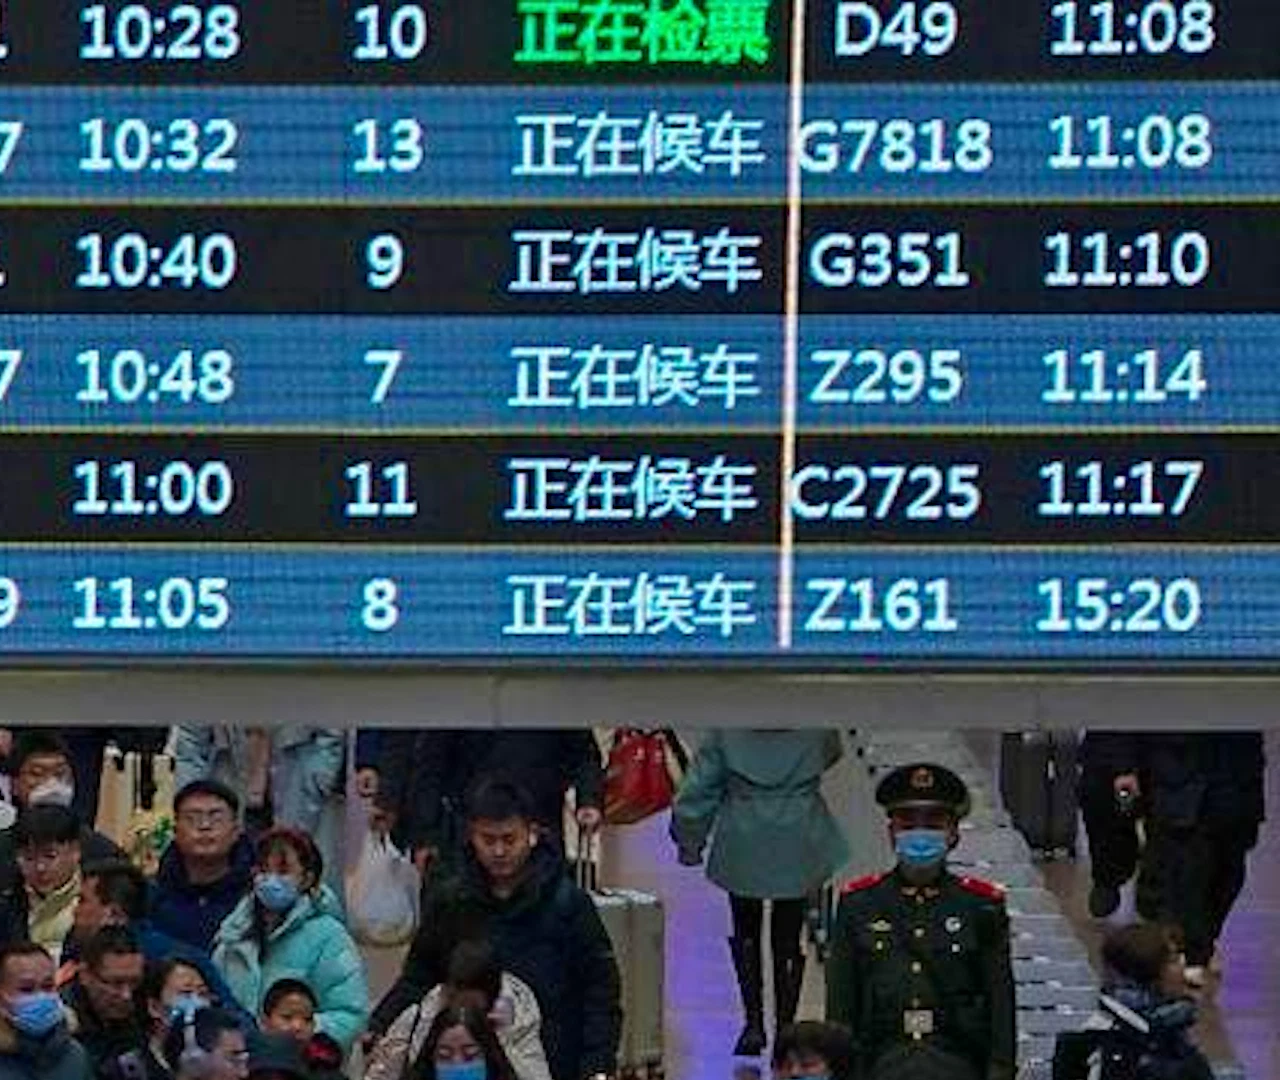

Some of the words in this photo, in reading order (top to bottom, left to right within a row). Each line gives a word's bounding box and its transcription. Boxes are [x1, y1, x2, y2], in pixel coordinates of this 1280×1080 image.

[81, 5, 239, 59] 10:28
[355, 5, 426, 59] 10
[514, 0, 769, 64] 正在检票
[834, 1, 958, 57] D49
[1052, 0, 1215, 55] 11:08
[78, 118, 238, 173] 10:32
[352, 118, 423, 173] 13
[511, 110, 766, 177] 正在候车
[798, 119, 993, 173] G7818
[1047, 113, 1212, 169] 11:08
[77, 234, 235, 287] 10:40
[368, 235, 403, 287] 9
[509, 228, 762, 293] 正在候车
[809, 232, 969, 287] G351
[1046, 232, 1208, 286] 11:10
[75, 349, 234, 403] 10:48
[363, 350, 402, 404] 7
[507, 343, 761, 410] 正在候车
[808, 350, 963, 404] Z295
[1041, 349, 1207, 403] 11:14
[74, 461, 232, 514] 11:00
[347, 463, 417, 515] 11
[505, 456, 757, 521] 正在候车
[789, 464, 981, 519] C2725
[1040, 461, 1202, 515] 11:17
[72, 576, 229, 630] 11:05
[360, 578, 398, 631] 8
[502, 571, 757, 637] 正在候车
[803, 578, 958, 632] Z161
[1036, 578, 1201, 632] 15:20
